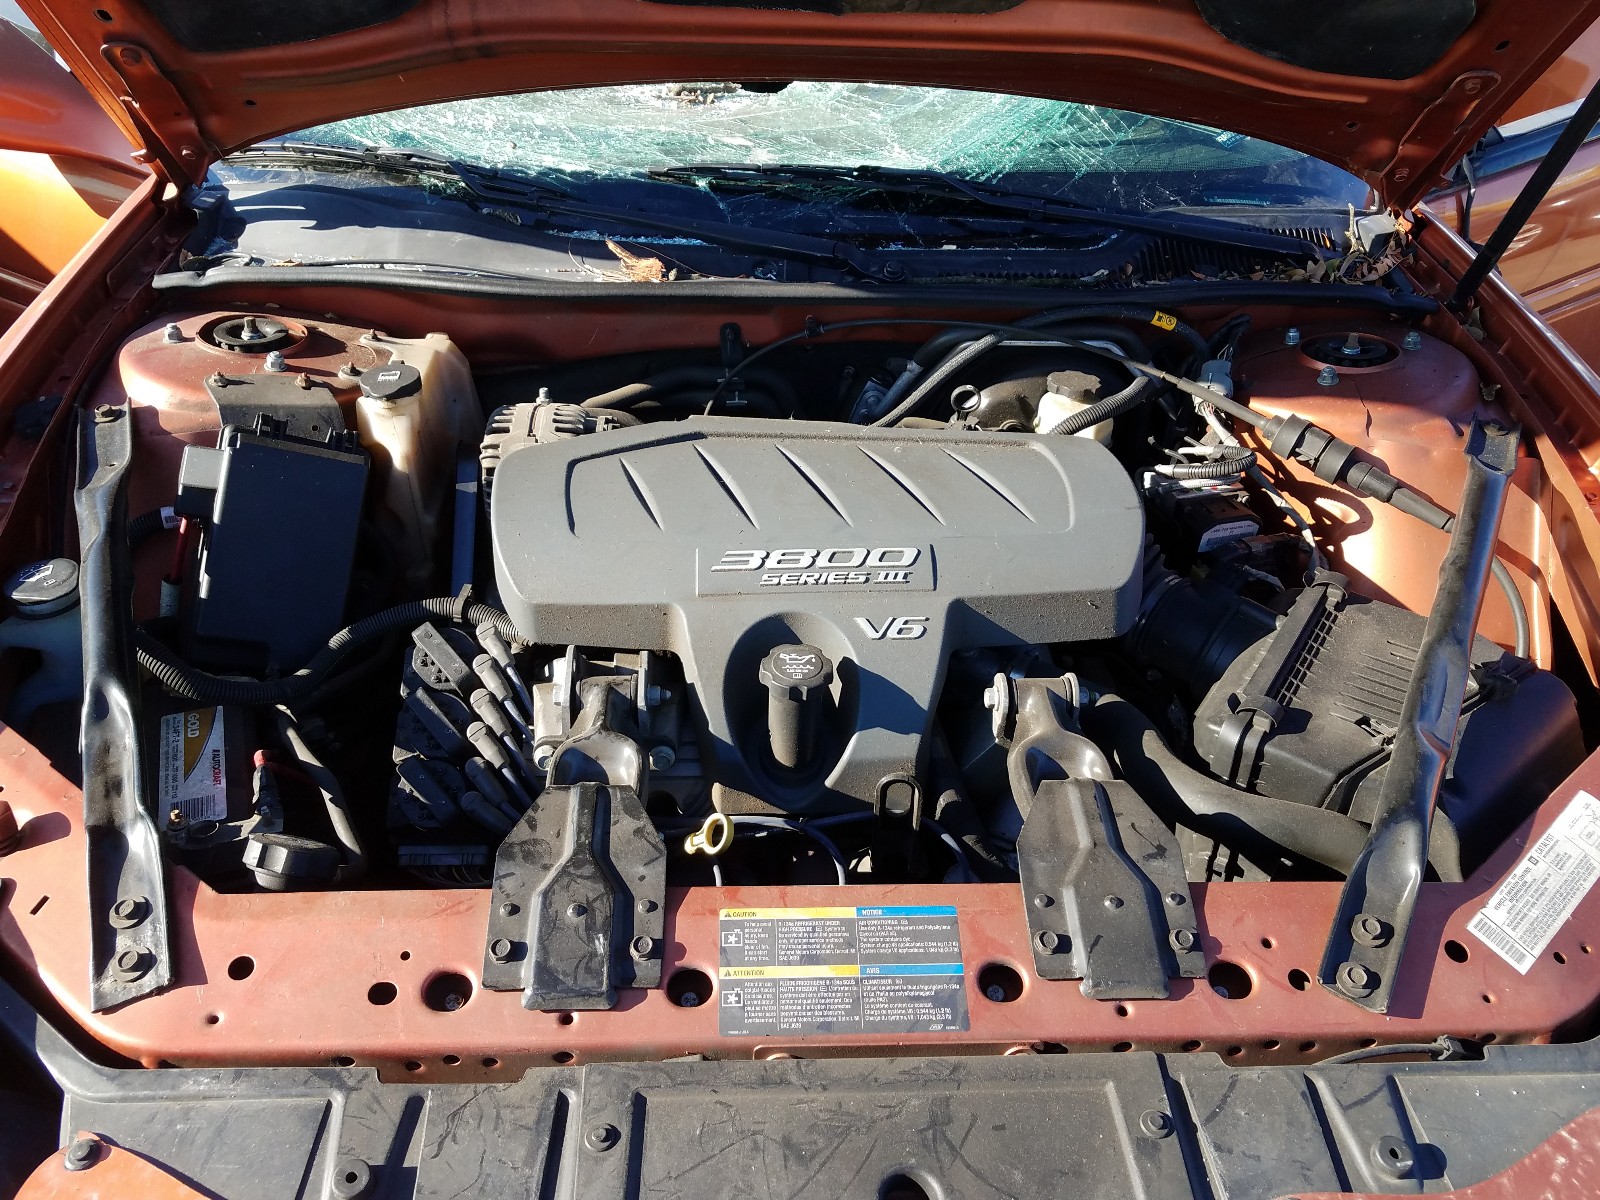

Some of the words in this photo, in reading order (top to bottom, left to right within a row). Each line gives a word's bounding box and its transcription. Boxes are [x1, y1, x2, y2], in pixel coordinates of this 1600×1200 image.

[710, 548, 920, 572] 3800
[759, 571, 870, 586] SERIES
[873, 570, 912, 584] III
[854, 616, 930, 640] V6
[188, 713, 199, 737] GOLD
[212, 754, 221, 786] AUTOCRAFT
[1535, 832, 1555, 856] CATALYST
